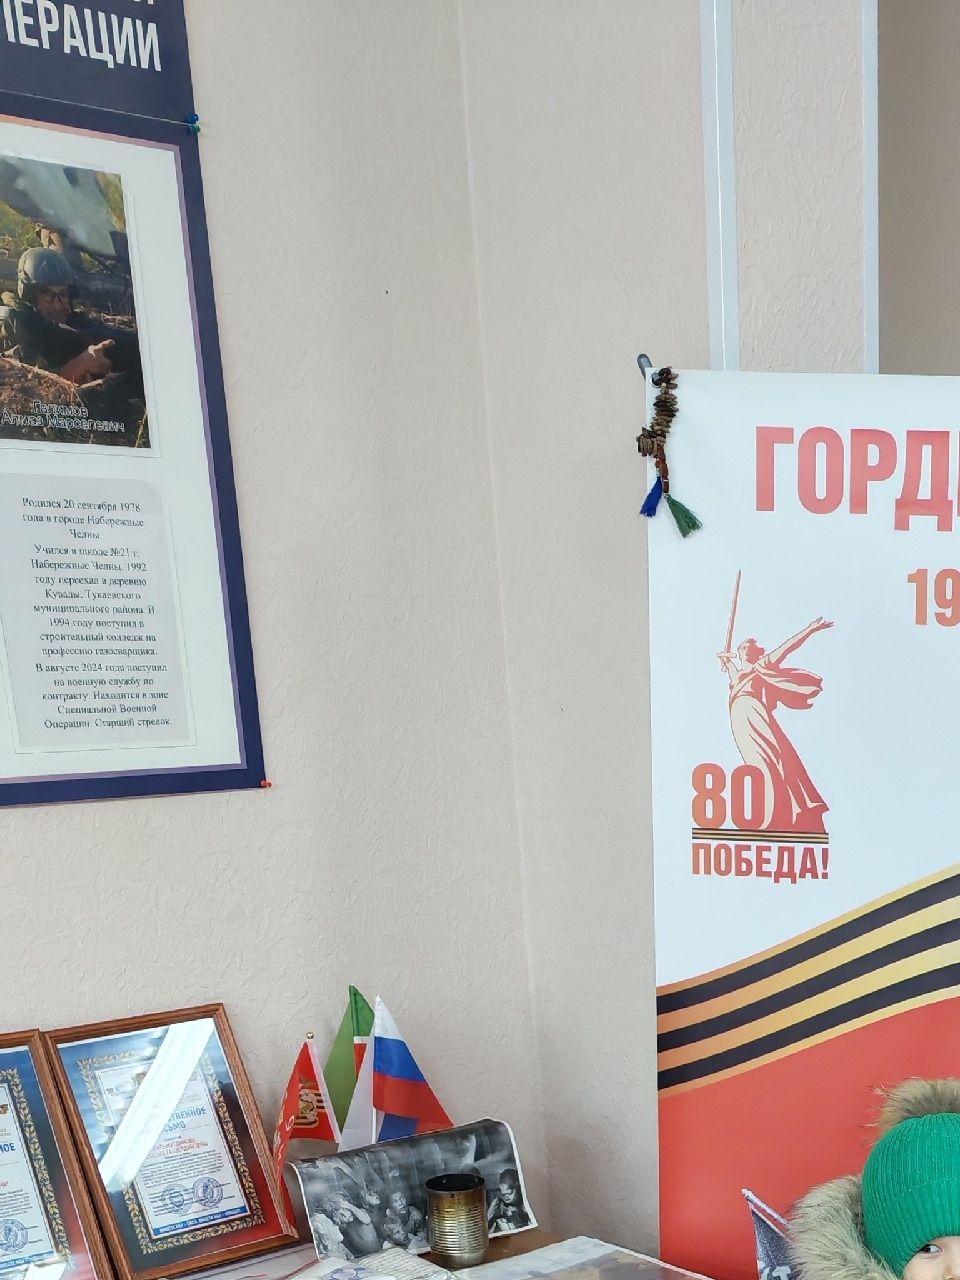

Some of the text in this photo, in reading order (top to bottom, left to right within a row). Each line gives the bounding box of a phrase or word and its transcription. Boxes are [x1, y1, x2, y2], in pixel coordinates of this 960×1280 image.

[22, 497, 61, 509] Родился
[63, 499, 75, 509] 20
[77, 501, 117, 513] сентября
[54, 516, 84, 525] городе
[31, 559, 89, 571] Набережные
[127, 563, 147, 572] 1992
[50, 618, 70, 627] 1994
[82, 663, 102, 672] 2024
[691, 763, 767, 831] 80
[691, 843, 829, 884] ПОБЕДА!
